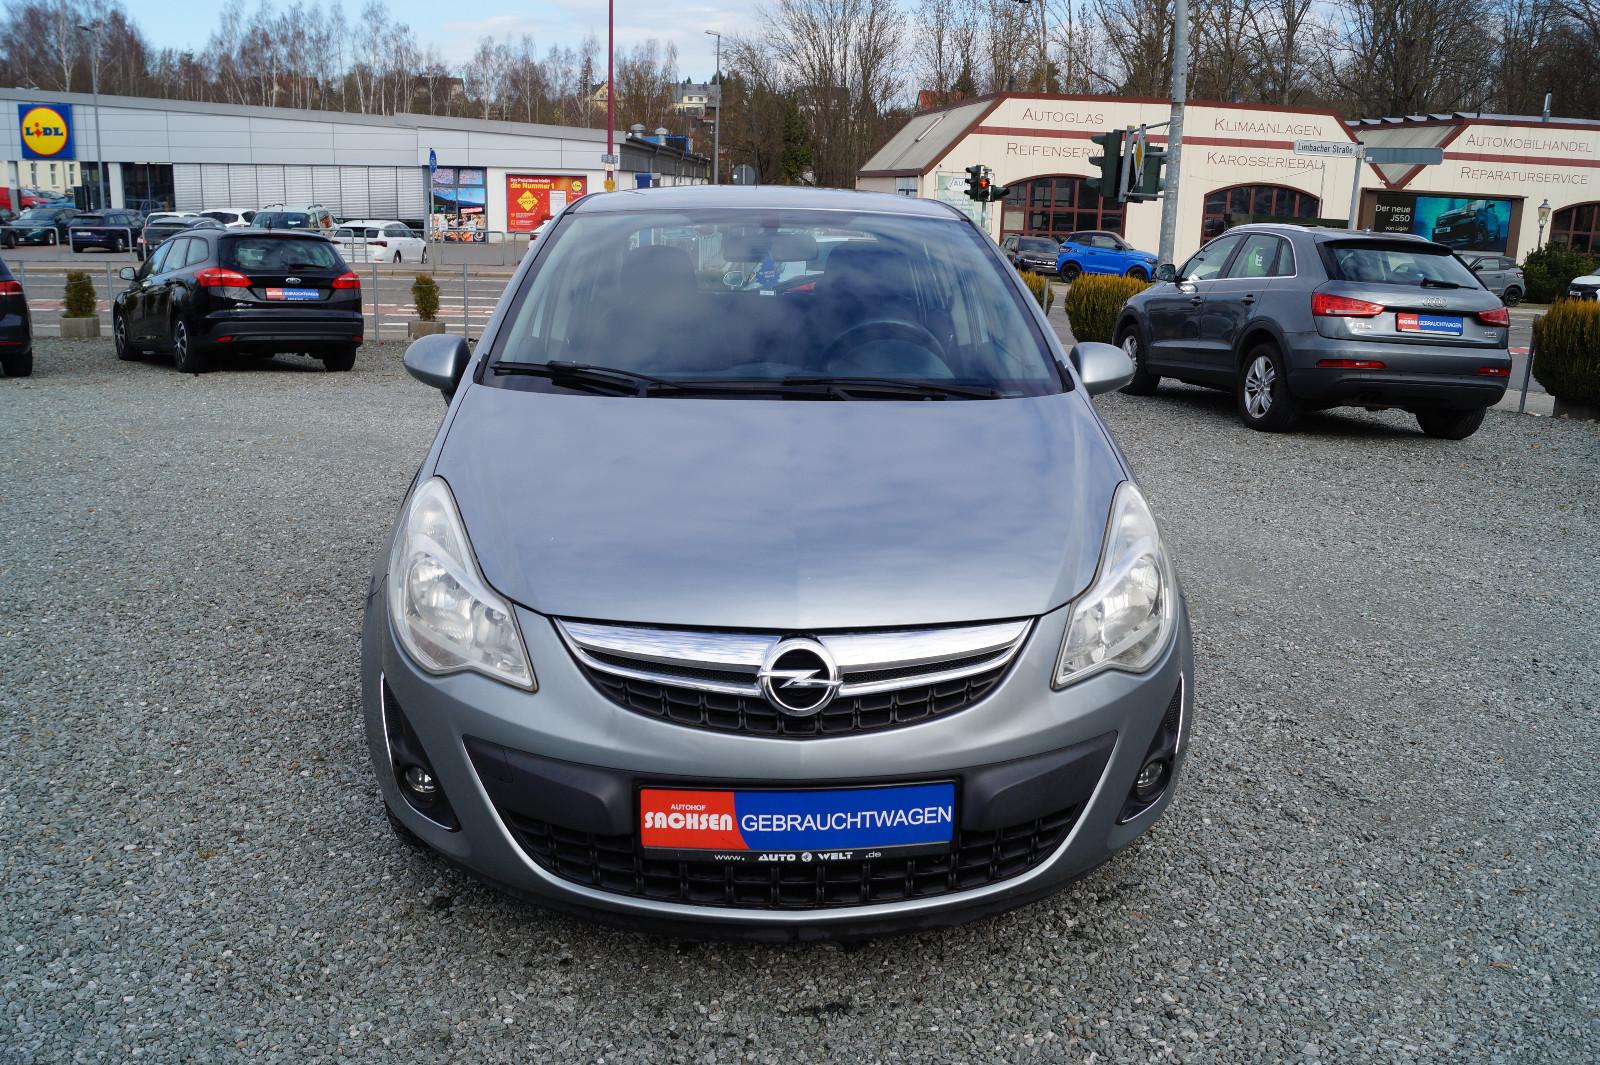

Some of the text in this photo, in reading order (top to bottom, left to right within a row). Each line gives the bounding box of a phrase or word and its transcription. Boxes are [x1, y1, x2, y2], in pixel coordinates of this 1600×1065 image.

[1022, 107, 1104, 125] AUTOGLAS
[1214, 117, 1323, 137] KLIMAANLAGEN
[1297, 142, 1353, 154] Limbacher Straße
[1465, 133, 1593, 153] AUTOMOBILHANDEL
[1206, 151, 1325, 170] KAROSSERIEBAU
[1460, 166, 1589, 185] REPARATURSERVICE
[1390, 214, 1411, 222] JS50
[670, 803, 706, 811] AUTOHOF
[644, 812, 733, 831] SACHSEN
[741, 805, 952, 832] GEBRAUCHTWAGEN
[758, 853, 796, 861] AUTO
[817, 851, 853, 860] WELT
